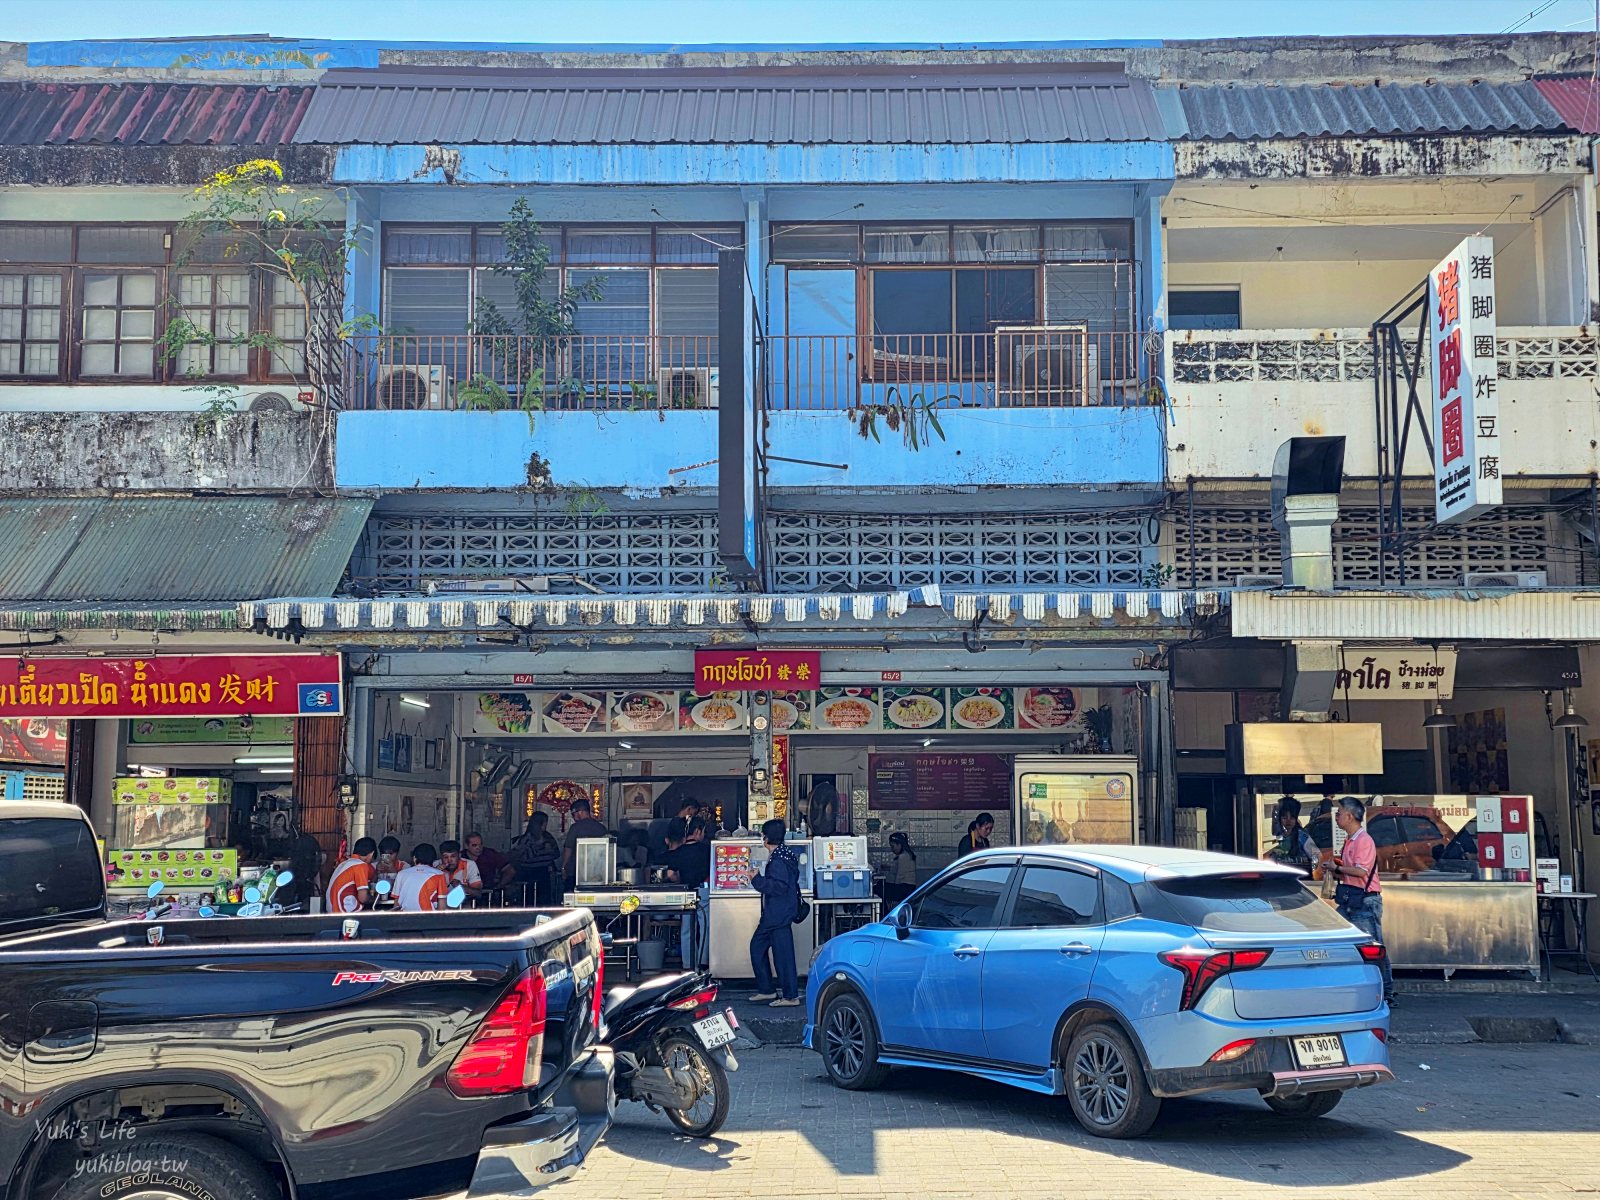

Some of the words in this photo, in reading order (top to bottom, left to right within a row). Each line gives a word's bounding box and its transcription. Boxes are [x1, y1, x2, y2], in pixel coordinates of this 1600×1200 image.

[1437, 259, 1464, 467] 猪脚圈
[1471, 254, 1499, 479] 猪脚圈炸豆腐
[882, 672, 900, 680] 45/2
[218, 673, 279, 705] 发财
[708, 1032, 730, 1047] 2487
[1316, 1037, 1339, 1051] 9018
